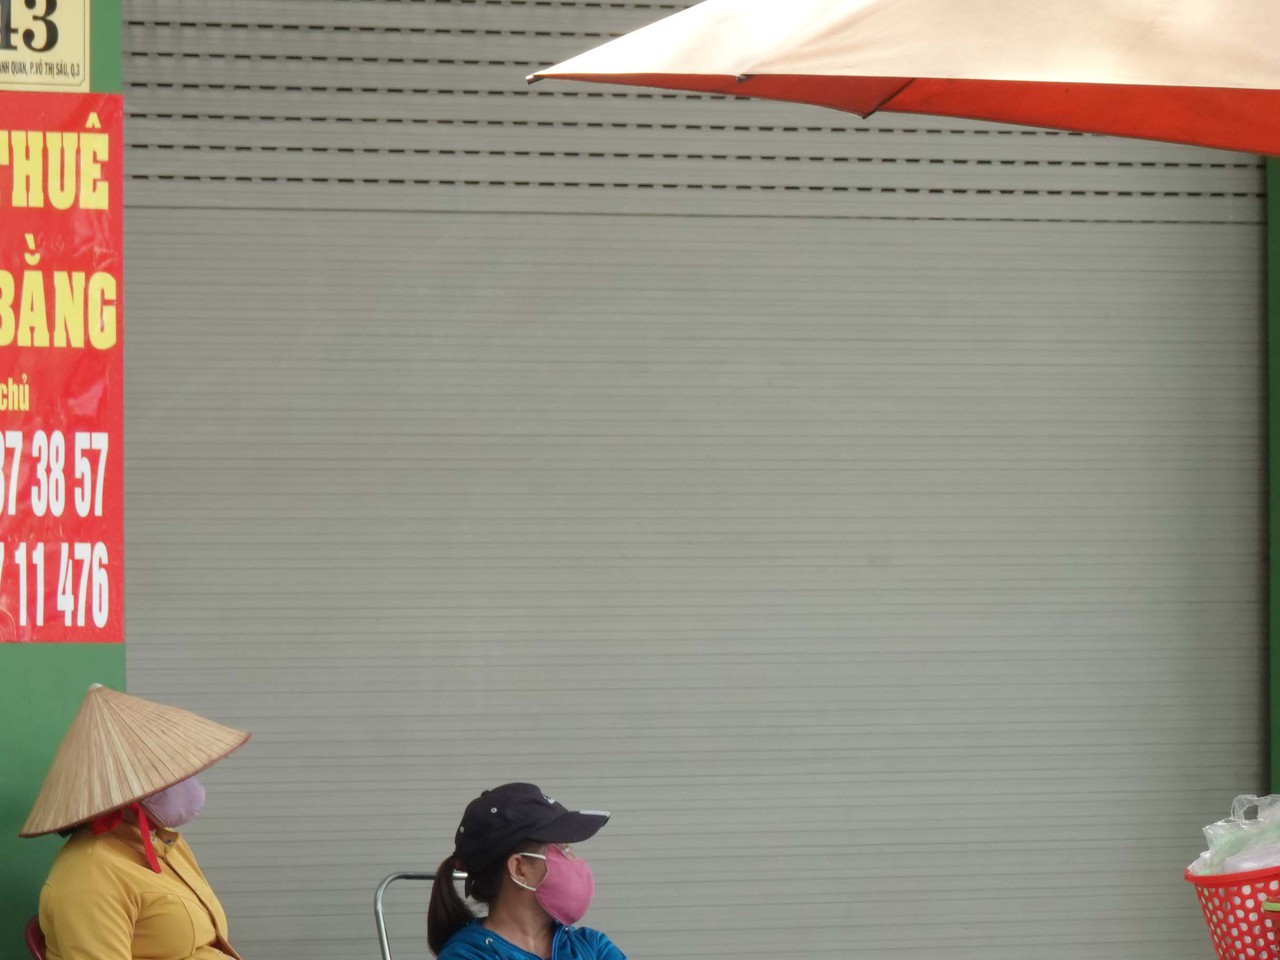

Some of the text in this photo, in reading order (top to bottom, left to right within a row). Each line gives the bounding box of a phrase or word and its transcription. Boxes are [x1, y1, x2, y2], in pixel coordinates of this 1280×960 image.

[0, 430, 108, 517] 7 38 57
[14, 542, 44, 627] 11
[57, 541, 109, 629] 476
